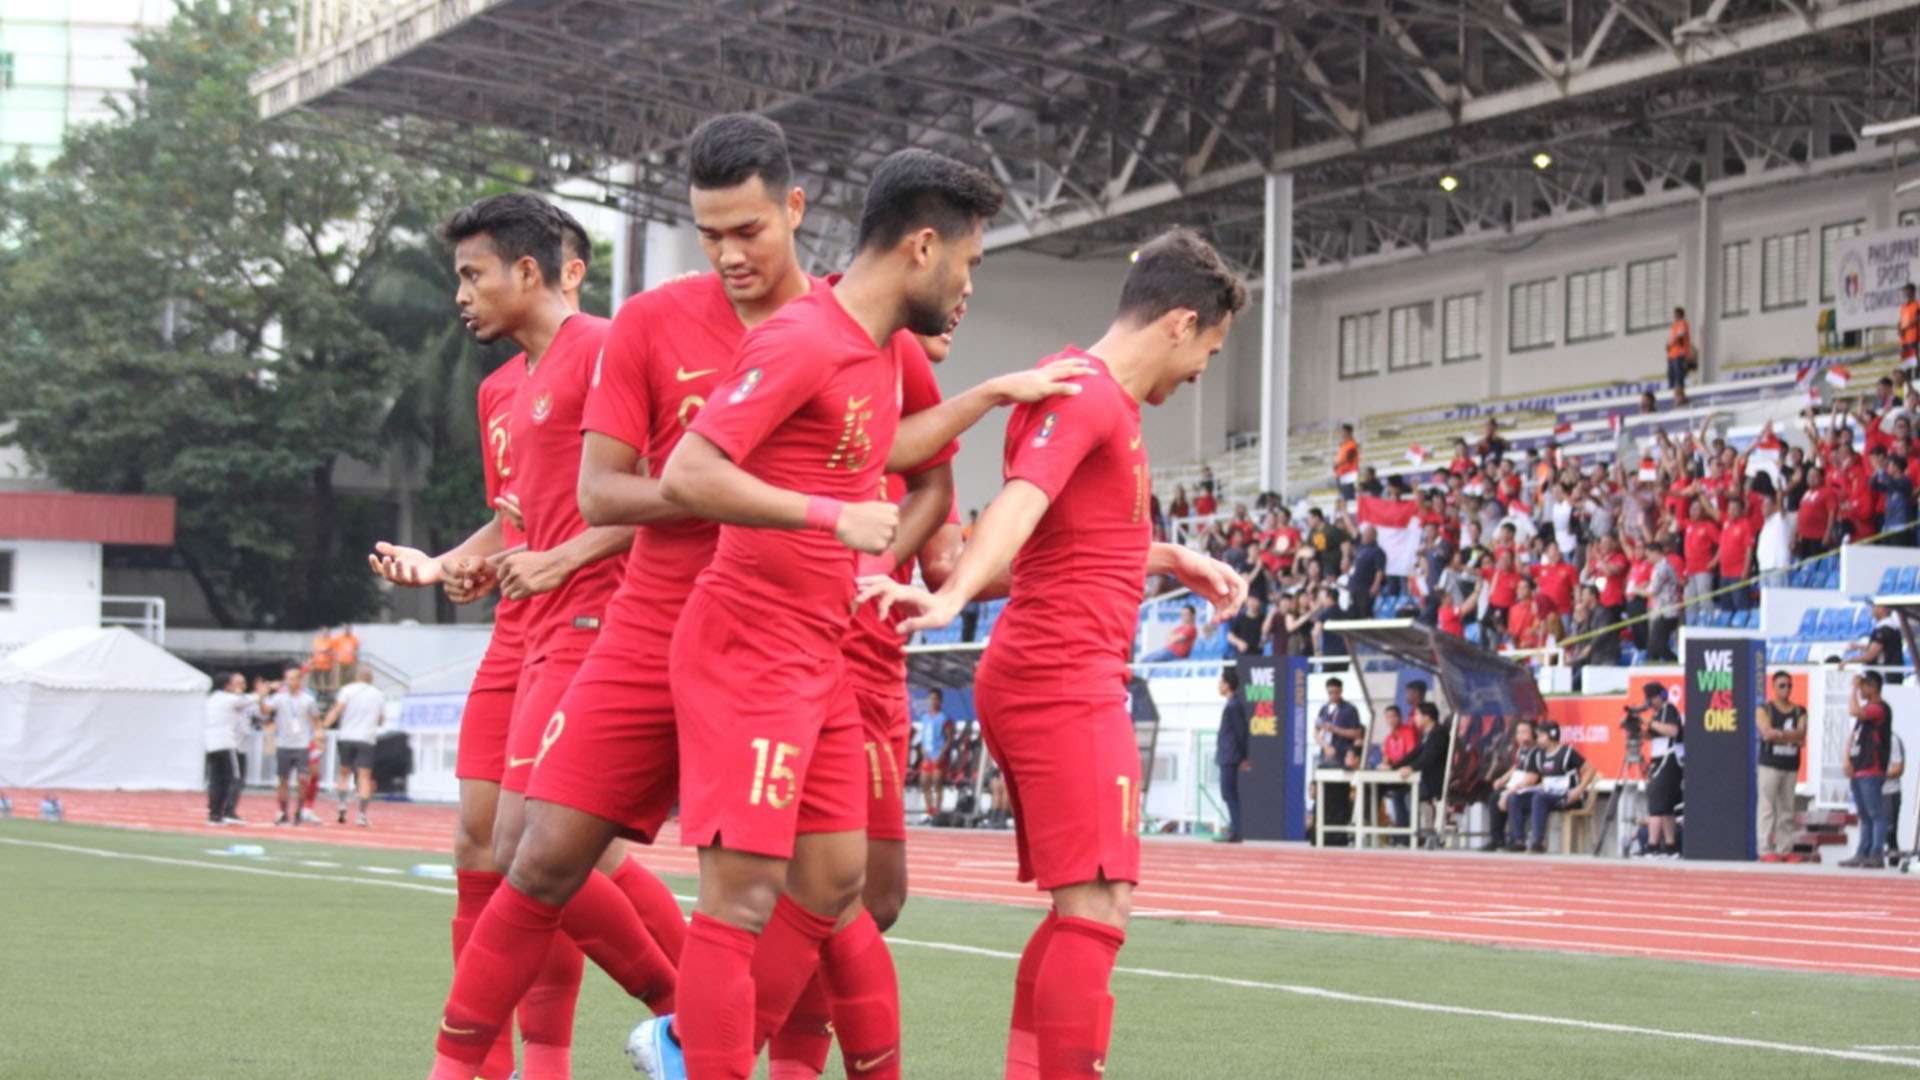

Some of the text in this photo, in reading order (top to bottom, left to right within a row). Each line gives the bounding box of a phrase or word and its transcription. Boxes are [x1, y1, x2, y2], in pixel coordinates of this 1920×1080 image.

[1876, 261, 1911, 288] SPORTS
[826, 410, 873, 473] 15
[1704, 649, 1733, 672] WE
[1250, 667, 1275, 686] WE
[1696, 670, 1733, 692] WIN
[1244, 684, 1275, 702] WIN
[1710, 690, 1733, 709] AS
[1254, 702, 1274, 718] AS
[1704, 708, 1737, 732] ONE
[1249, 716, 1278, 736] ONE
[535, 711, 566, 767] 9
[750, 738, 800, 809] 15
